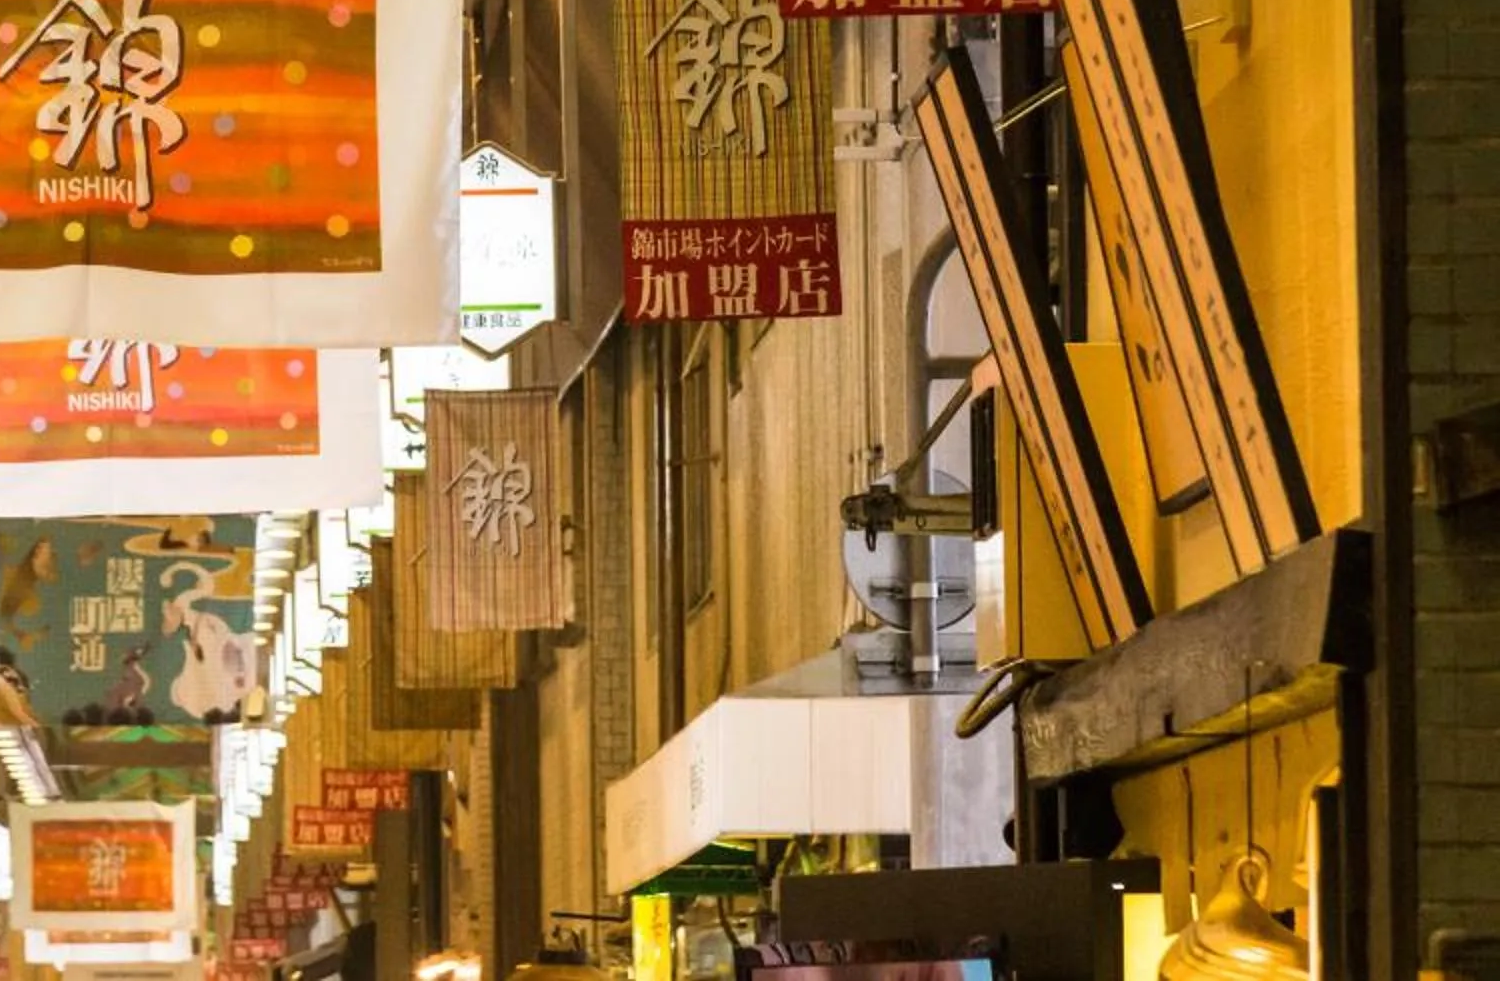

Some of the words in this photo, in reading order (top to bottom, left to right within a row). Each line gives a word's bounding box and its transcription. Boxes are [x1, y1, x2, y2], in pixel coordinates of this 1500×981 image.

[37, 176, 137, 206] NISHIKI
[631, 222, 829, 262] 錦市場ポイントカード
[633, 258, 832, 319] 加盟店
[67, 393, 142, 412] NISHIKI
[442, 440, 536, 558] 錦
